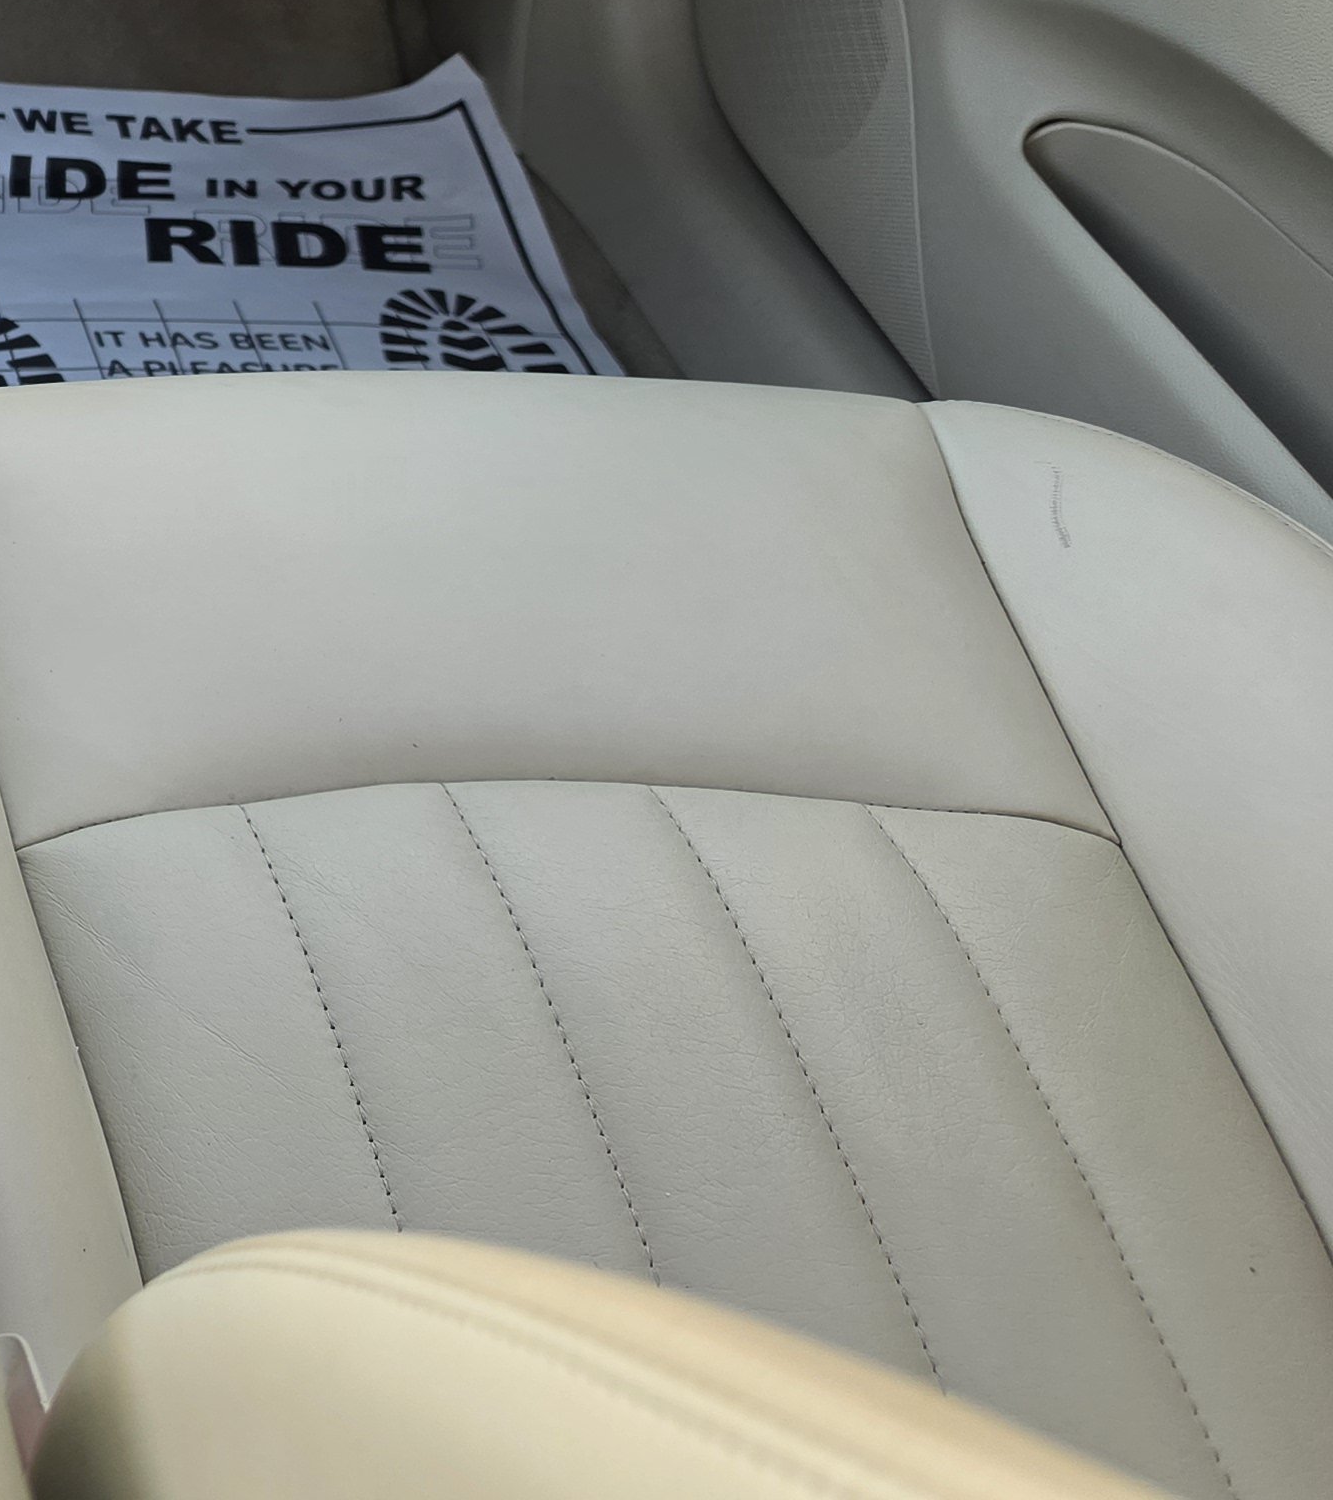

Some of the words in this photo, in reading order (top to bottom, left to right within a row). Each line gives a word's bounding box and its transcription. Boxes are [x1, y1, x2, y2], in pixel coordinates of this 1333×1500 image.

[12, 106, 95, 137] WE
[104, 113, 245, 146] TAKE
[205, 178, 259, 199] IN
[276, 174, 426, 202] YOUR
[144, 217, 433, 274] RIDE
[92, 330, 126, 348] IT
[138, 331, 220, 350] HAS
[228, 331, 334, 352] BEEN
[106, 359, 133, 377] A
